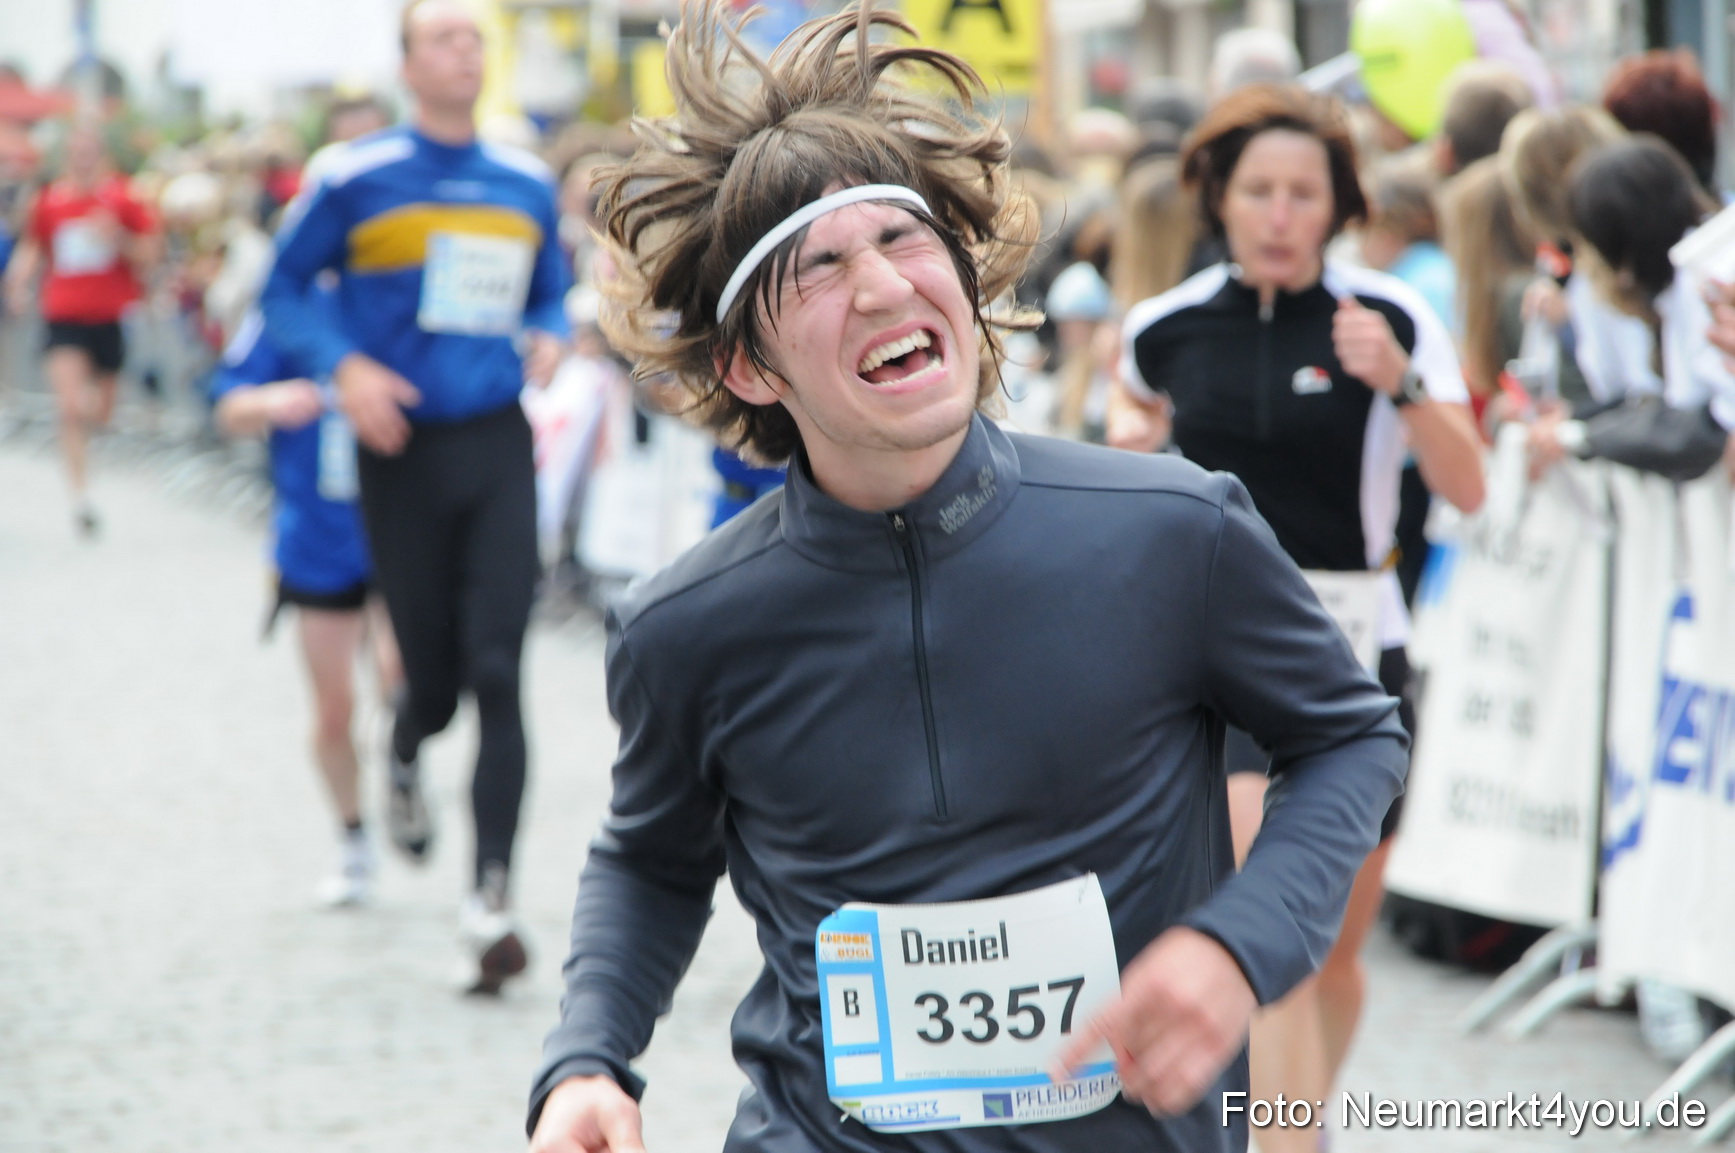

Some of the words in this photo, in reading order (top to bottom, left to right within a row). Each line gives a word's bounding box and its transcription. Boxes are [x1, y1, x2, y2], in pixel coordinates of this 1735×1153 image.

[900, 921, 1010, 965] Daniel
[843, 989, 860, 1017] B
[914, 976, 1086, 1044] 3357
